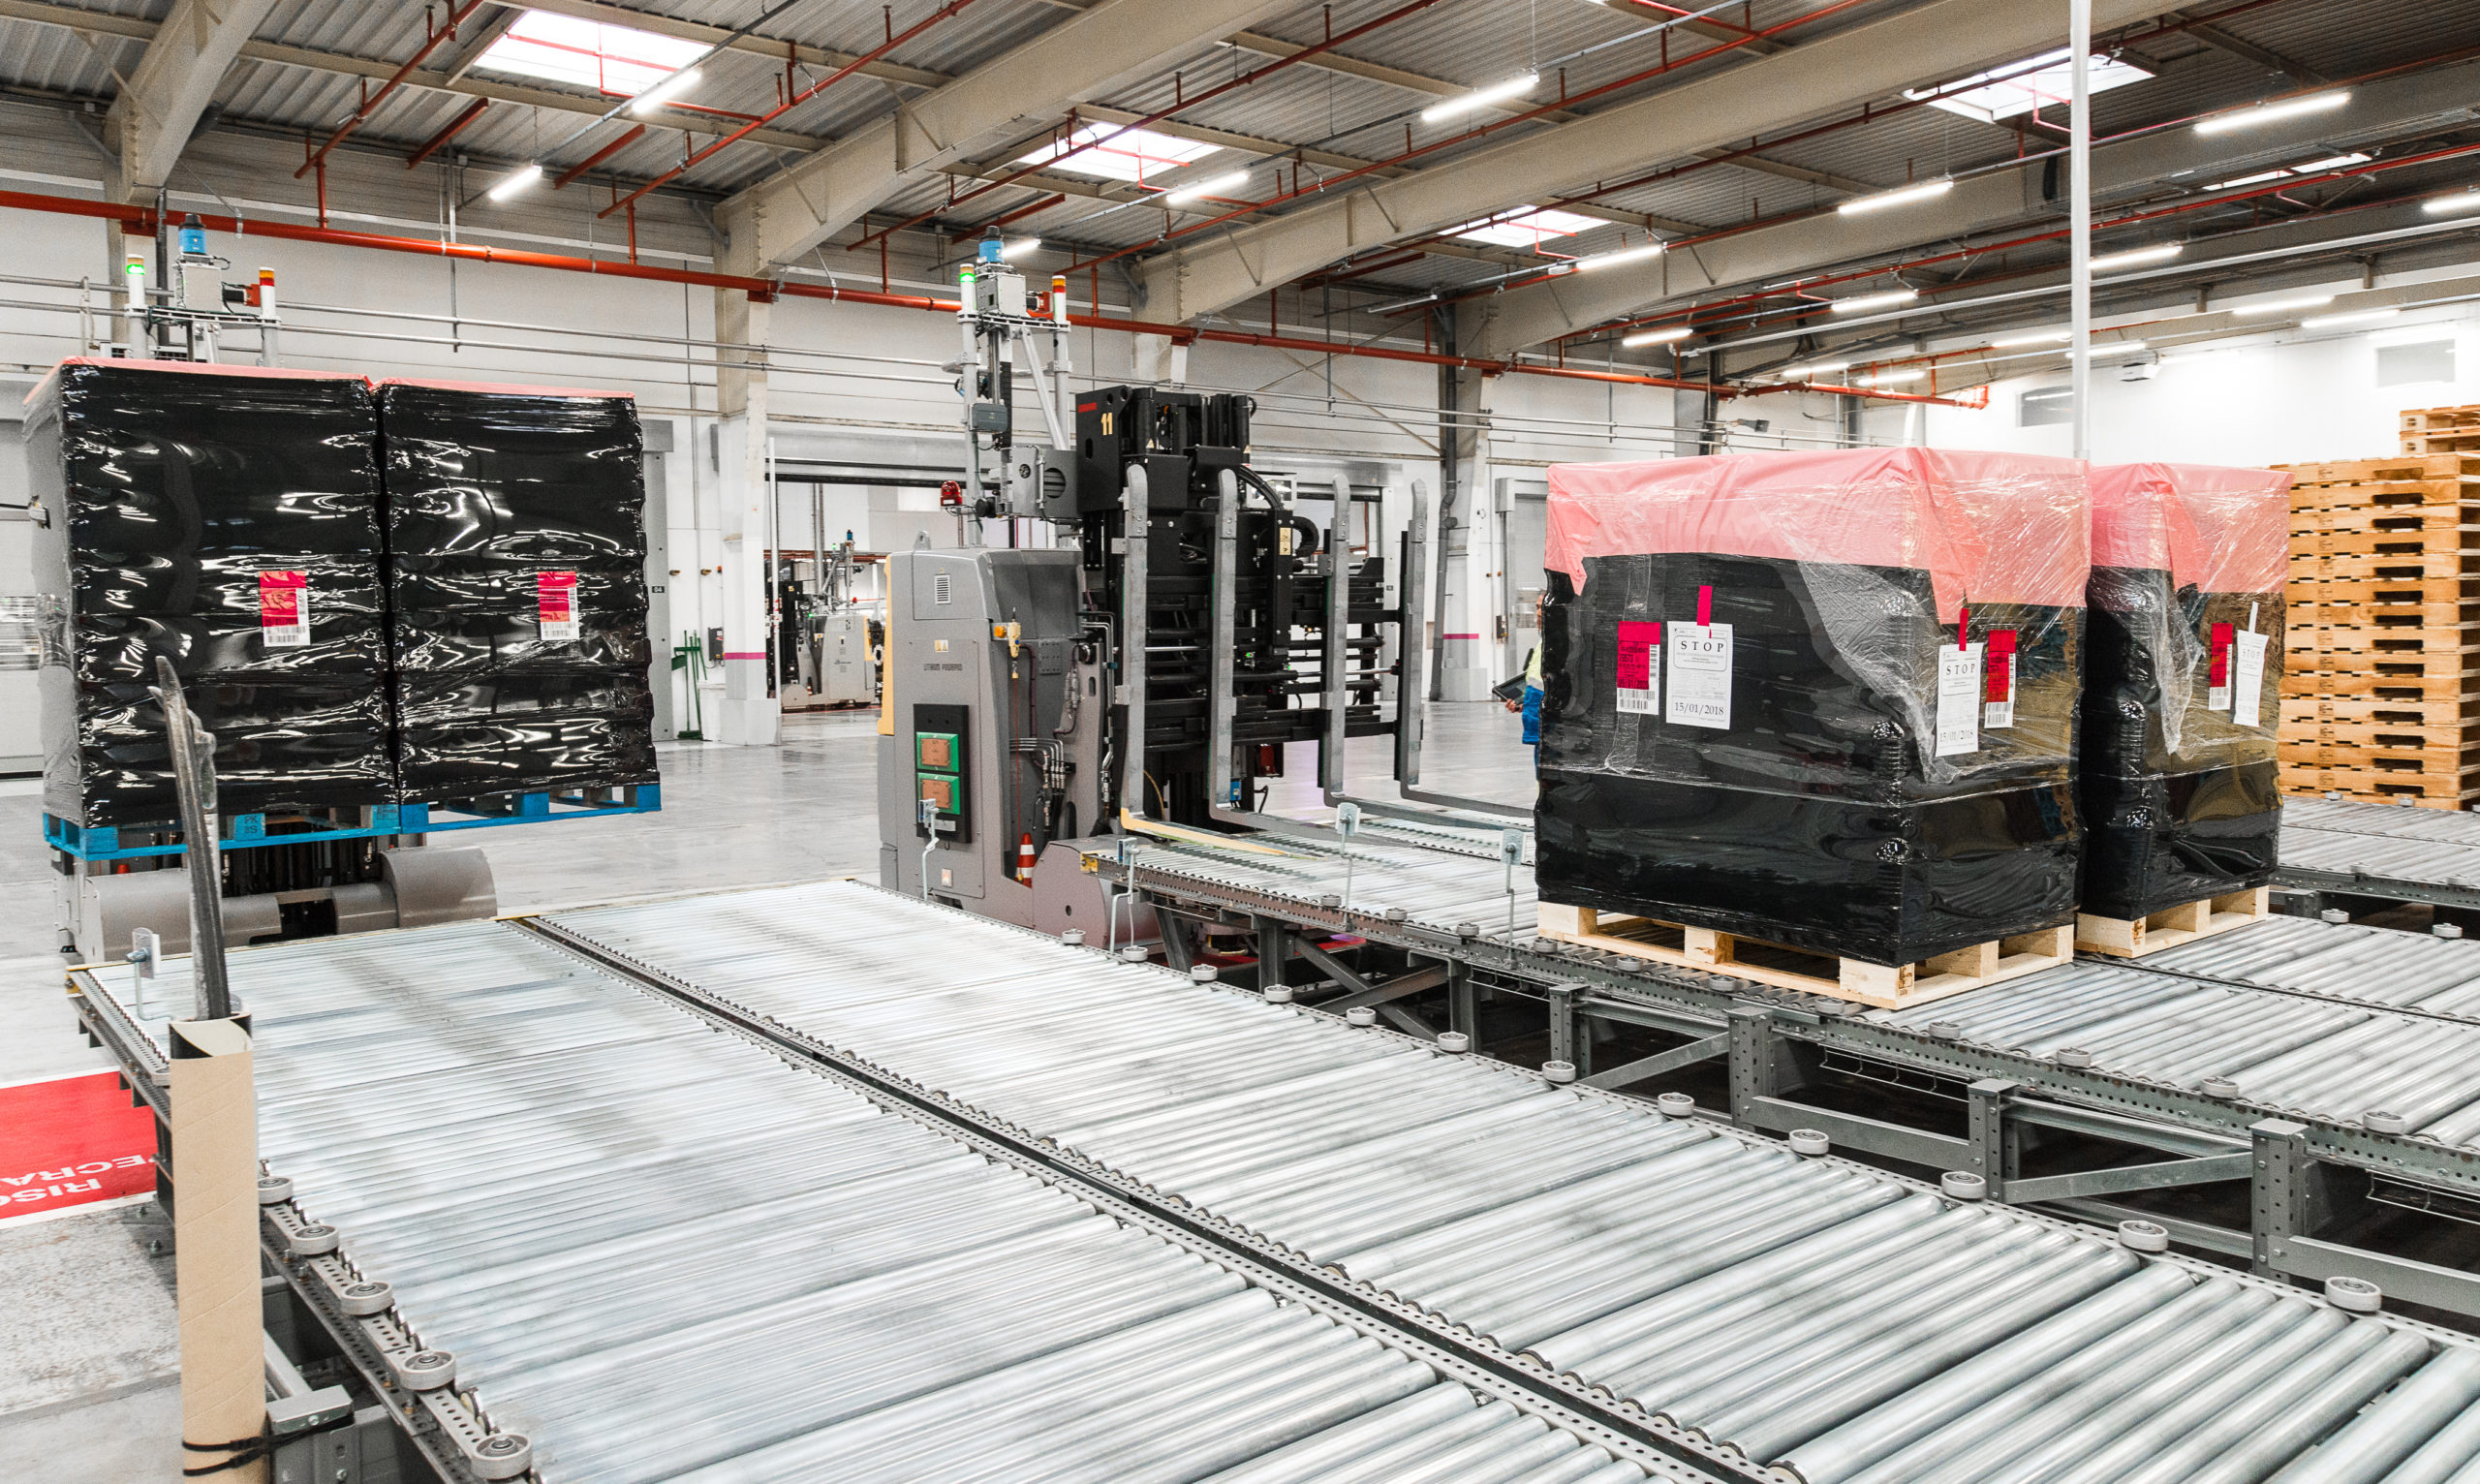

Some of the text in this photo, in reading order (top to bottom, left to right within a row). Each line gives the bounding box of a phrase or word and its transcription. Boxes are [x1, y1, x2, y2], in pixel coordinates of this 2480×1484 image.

[1100, 412, 1113, 436] 11
[1681, 640, 1724, 653] STOP
[1945, 663, 1975, 676] STOP
[1674, 701, 1724, 716] 15/01/2018
